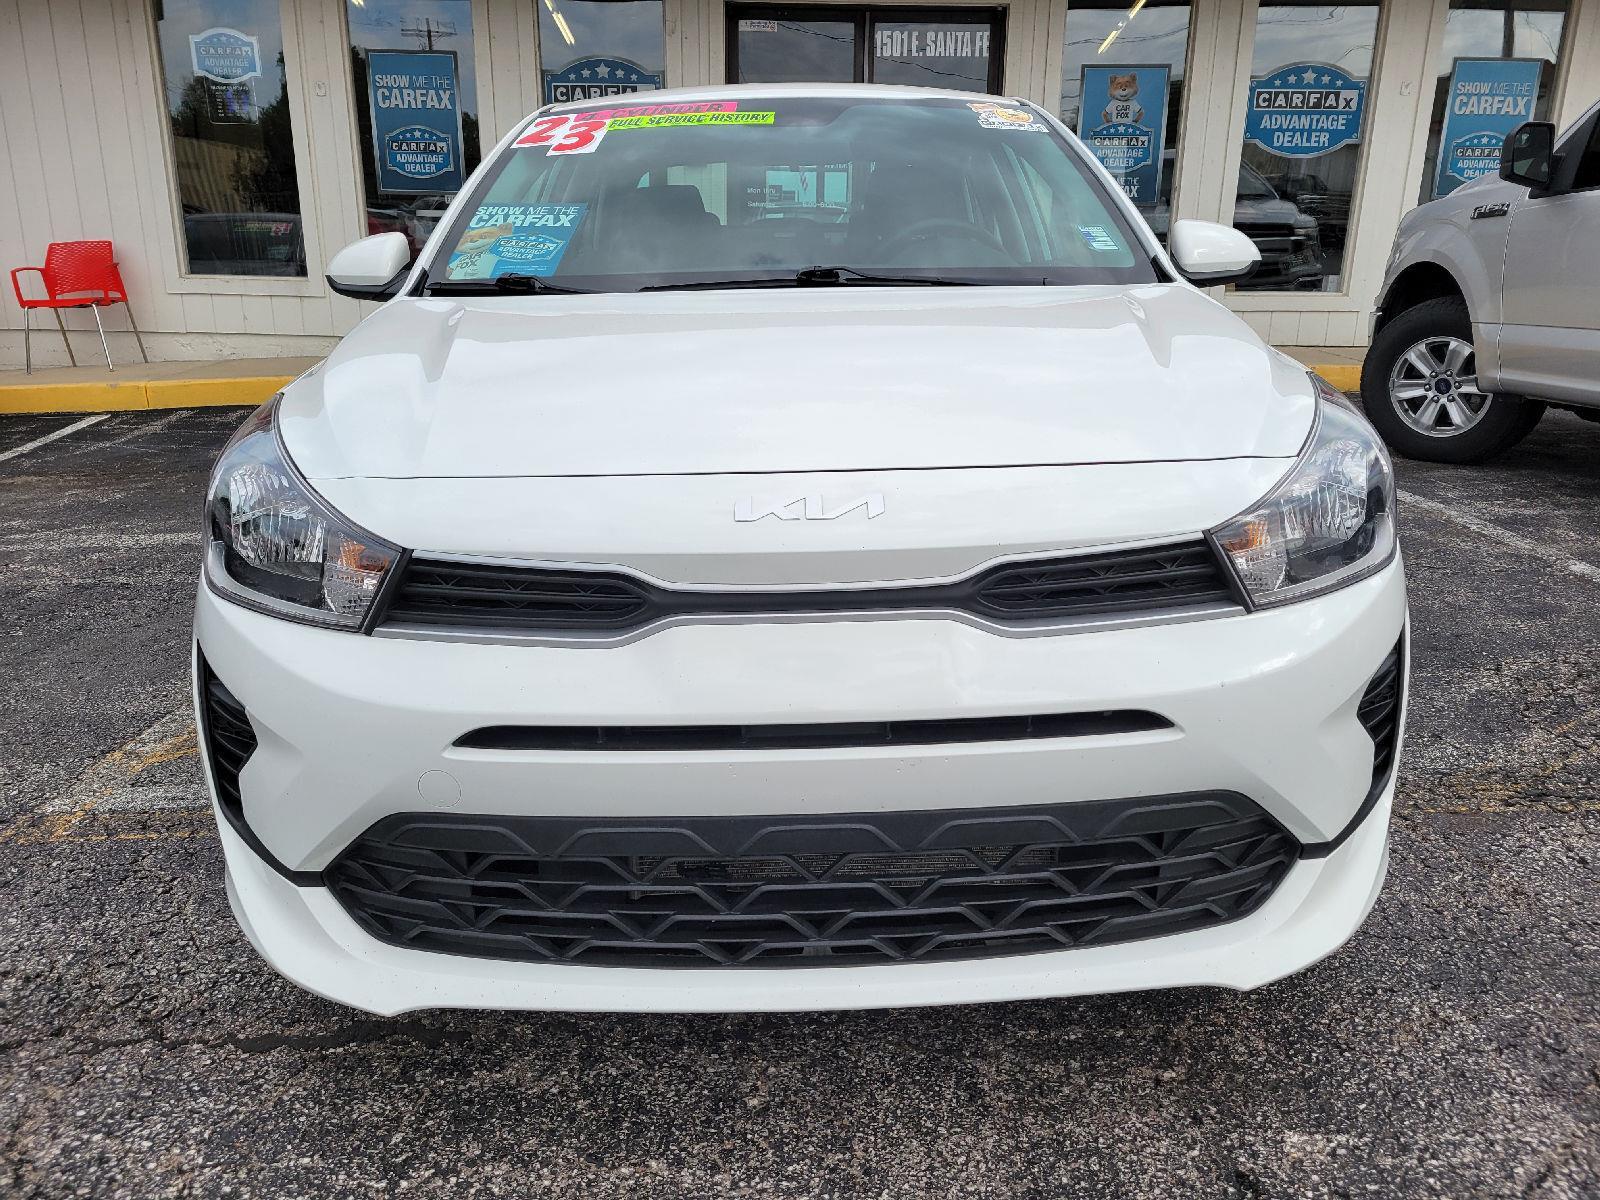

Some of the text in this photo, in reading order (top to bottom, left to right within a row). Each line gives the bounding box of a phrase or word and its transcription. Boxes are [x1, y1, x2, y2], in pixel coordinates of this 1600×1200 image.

[874, 30, 991, 57] 1501 E. SANTA FE
[200, 46, 252, 56] CARFAX
[204, 57, 250, 67] ADVANTAGE
[213, 67, 242, 75] DEALER
[375, 74, 451, 89] SHOW ME THE
[1456, 82, 1532, 95] SHOW ME THE
[376, 88, 453, 110] CARFAX
[1254, 89, 1358, 110] CARFAX
[1115, 104, 1131, 112] CAR
[1454, 96, 1529, 116] CARFAX
[609, 112, 771, 129] FULL SERVICE HISTORY
[1115, 111, 1130, 120] FOX
[1260, 114, 1347, 130] ADVANTAGE
[1093, 136, 1148, 147] CARFAX
[1273, 131, 1330, 147] DEALER
[391, 141, 448, 153] CARFAX
[1456, 147, 1504, 157] CARFA
[396, 153, 444, 164] ADVANTAGE
[1097, 148, 1143, 158] ADVANTAGE
[404, 163, 437, 173] DEALER
[1103, 158, 1135, 167] DEALER
[476, 206, 580, 215] SHOW ME THE
[469, 214, 578, 228] CARFAX
[500, 239, 557, 250] CARFAX
[497, 246, 546, 255] ADVANTAGE
[500, 252, 534, 260] DEALER
